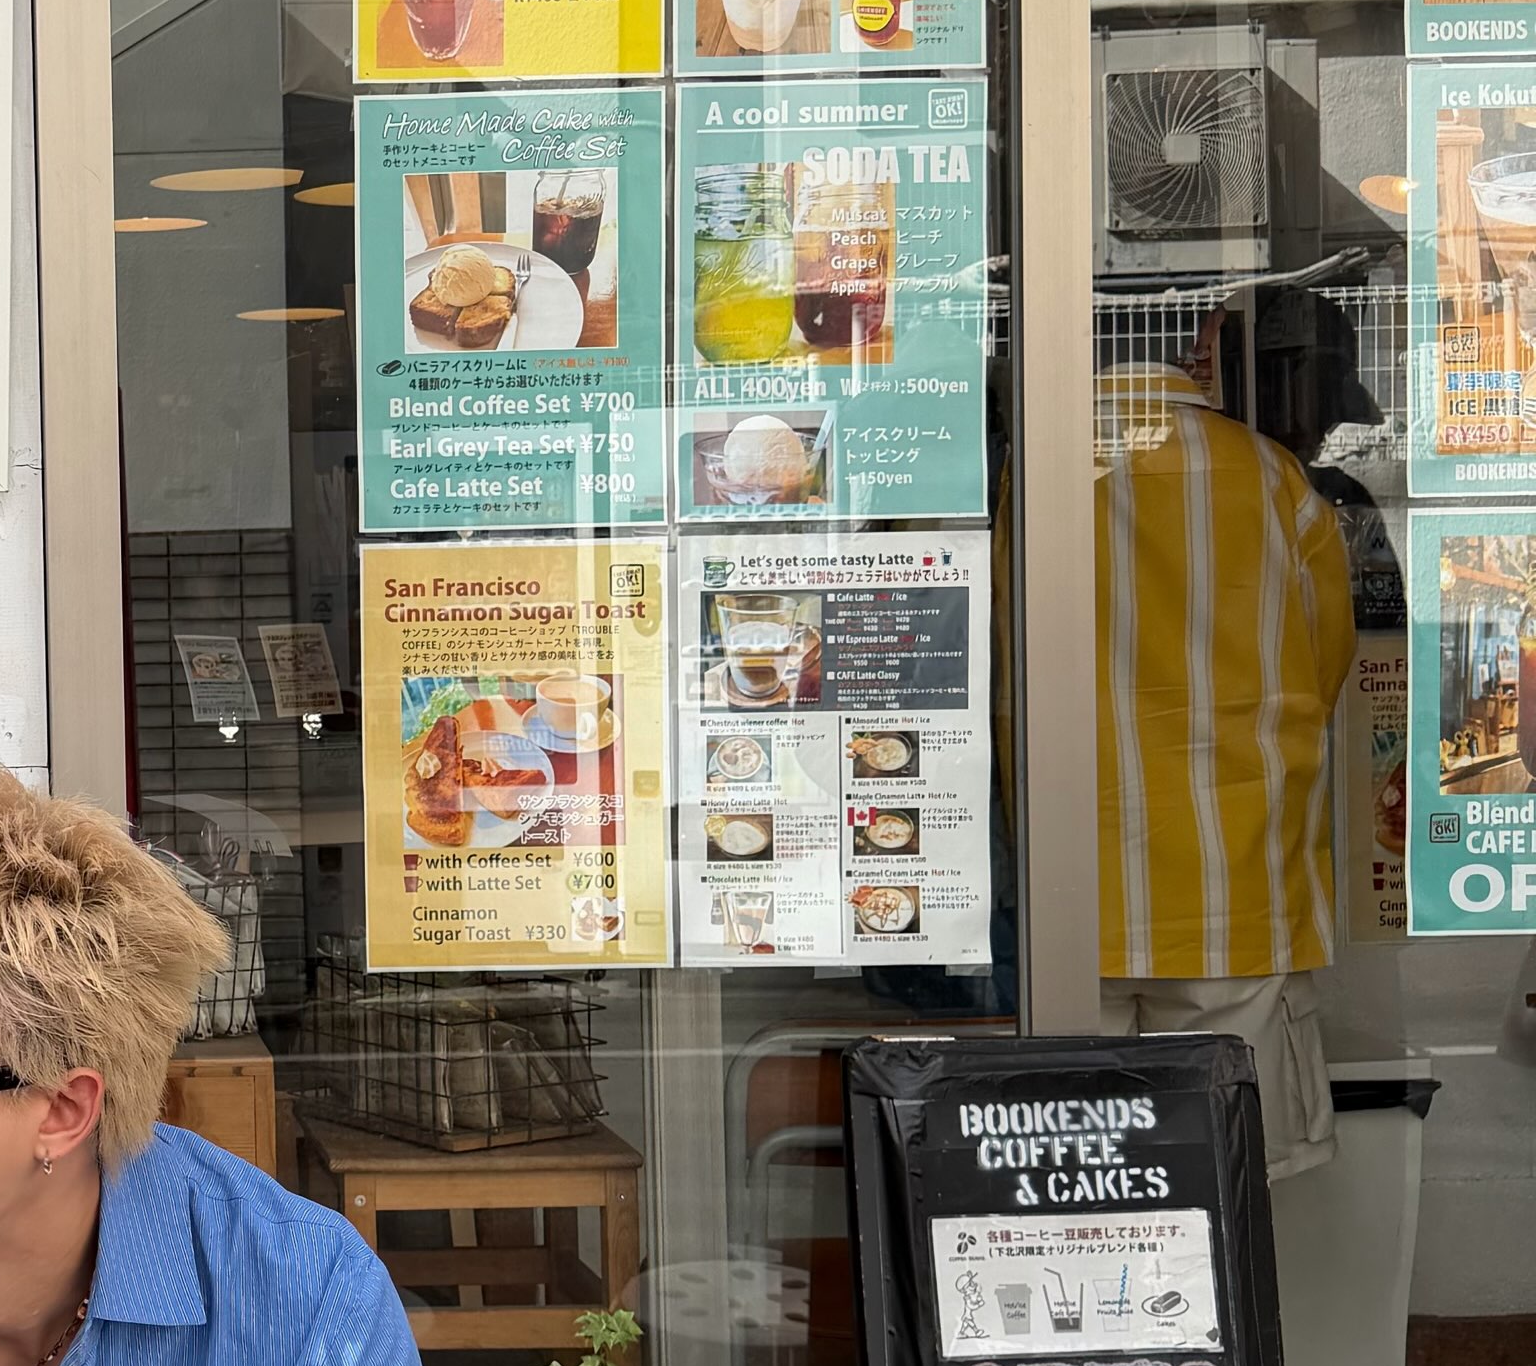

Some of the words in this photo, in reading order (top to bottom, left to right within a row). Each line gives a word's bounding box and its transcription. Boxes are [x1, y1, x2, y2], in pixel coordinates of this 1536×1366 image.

[1426, 19, 1528, 42] BOOKENDS
[1441, 84, 1471, 106] Ice
[704, 101, 723, 125] A
[732, 99, 788, 125] cool
[798, 102, 908, 124] summer
[934, 101, 963, 119] OK!
[382, 112, 451, 141] Home
[455, 109, 526, 137] Made
[531, 108, 593, 134] Cake
[597, 107, 634, 127] with
[382, 142, 486, 155] 手作りケーキとコーヒー
[501, 136, 574, 167] Coffee
[578, 135, 627, 160] Set
[382, 154, 476, 168] のセットメニューです
[802, 145, 900, 185] SODA
[907, 144, 971, 183] TEA
[830, 208, 887, 223] Muscat
[895, 205, 974, 222] マスカット
[830, 231, 877, 246] Peach
[830, 255, 878, 271] Grape
[830, 280, 866, 296] Apple
[407, 358, 527, 373] バニラアイスクリームに
[694, 376, 735, 399] ALL
[742, 376, 827, 403] 400yen
[389, 396, 453, 418] Blend
[458, 394, 529, 416] Coffee
[534, 393, 570, 413] Set
[580, 391, 635, 412] ¥700
[1449, 399, 1477, 416] ICE
[842, 426, 952, 443] アイスクリーム
[389, 437, 431, 459] Earl
[437, 436, 488, 461] Grey
[493, 435, 533, 456] Tea
[539, 434, 574, 454] Set
[580, 433, 634, 453] ¥750
[845, 447, 921, 464] トッピング
[390, 478, 440, 499] Cafe
[445, 477, 503, 498] Latte
[507, 475, 543, 496] Set
[580, 473, 635, 494] ¥800
[844, 470, 913, 486] +150yen
[740, 555, 772, 568] Let's
[775, 556, 798, 569] get
[801, 555, 837, 567] some
[841, 554, 875, 568] tasty
[878, 553, 914, 565] Latte
[384, 579, 426, 598] San
[432, 575, 541, 598] Francisco
[384, 604, 503, 623] Cinnamon
[508, 601, 576, 625] Sugar
[580, 600, 646, 619] Toast
[1359, 659, 1390, 674] San
[1466, 798, 1534, 826] Blend
[1465, 829, 1525, 854] CAFE
[425, 854, 462, 869] with
[466, 853, 520, 869] Coffee
[525, 853, 552, 868] Set
[572, 851, 614, 867] ¥600
[426, 876, 462, 892] with
[467, 876, 511, 890] Latte
[514, 875, 541, 890] Set
[572, 874, 614, 889] ¥700
[412, 906, 498, 921] Cinnamon
[413, 926, 461, 944] Sugar
[465, 926, 511, 941] Toast
[524, 925, 566, 940] ¥330
[960, 1097, 1157, 1137] BOOKENDS
[977, 1133, 1125, 1170] COFFEE
[1016, 1173, 1040, 1206] &
[1046, 1167, 1170, 1204] CAKES
